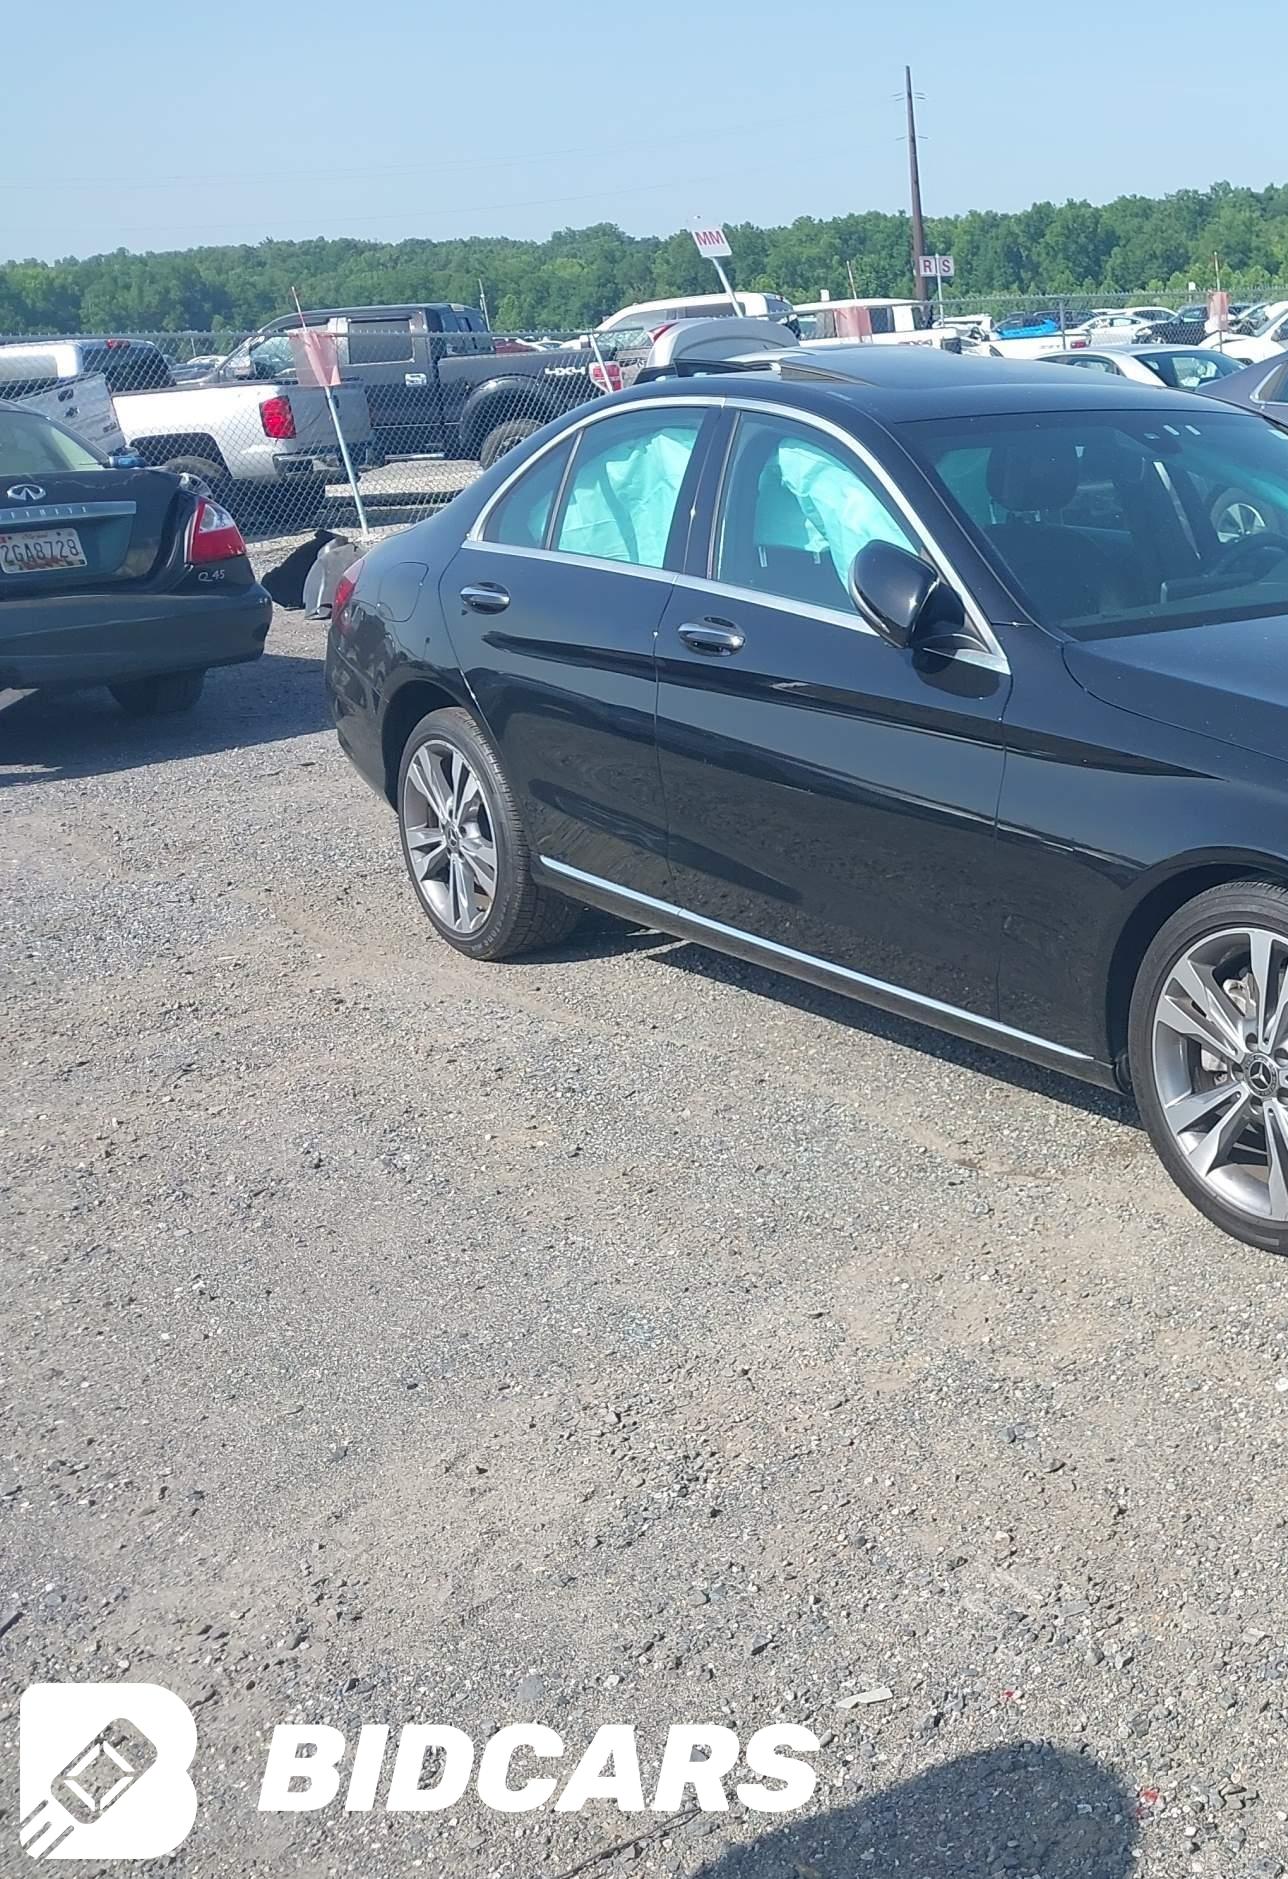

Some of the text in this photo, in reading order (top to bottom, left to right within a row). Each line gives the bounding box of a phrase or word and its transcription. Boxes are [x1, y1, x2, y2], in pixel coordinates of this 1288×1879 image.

[694, 230, 725, 245] MM
[923, 259, 932, 273] R
[942, 259, 951, 273] S
